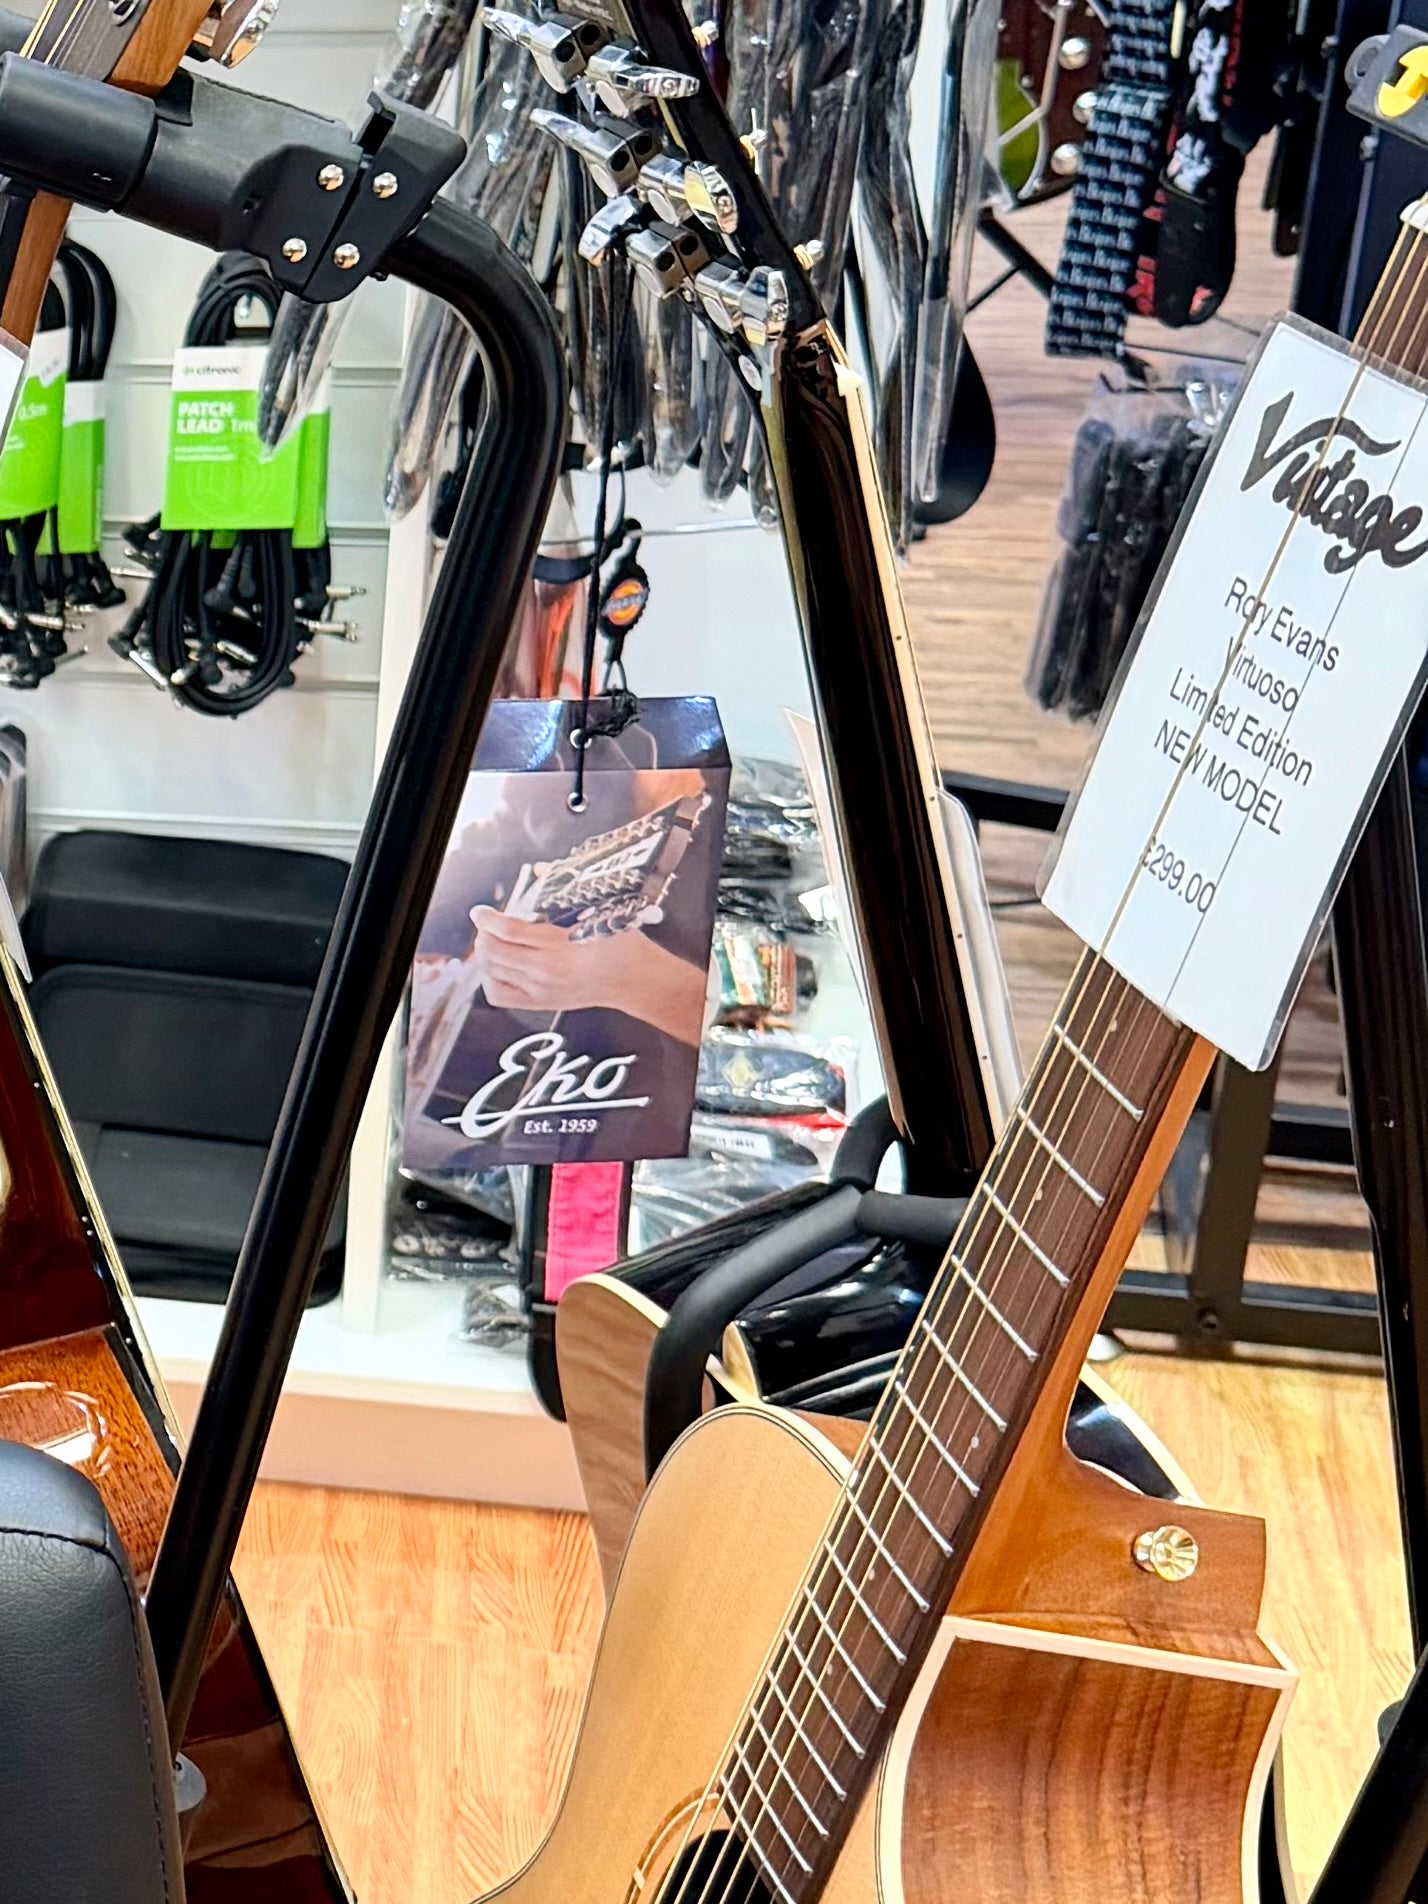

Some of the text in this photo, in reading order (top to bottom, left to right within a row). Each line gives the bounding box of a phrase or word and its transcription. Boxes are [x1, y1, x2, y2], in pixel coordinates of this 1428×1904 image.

[176, 419, 222, 435] LEAD
[177, 400, 235, 419] PATCH
[1241, 391, 1428, 574] Vintage
[1224, 576, 1341, 673] Rory Evans
[1228, 636, 1299, 715] Virtuoso
[1153, 720, 1283, 838] NEW MODEL
[1235, 709, 1314, 788] Edition
[460, 1031, 638, 1139] Eko
[523, 1117, 598, 1136] Est. 1959
